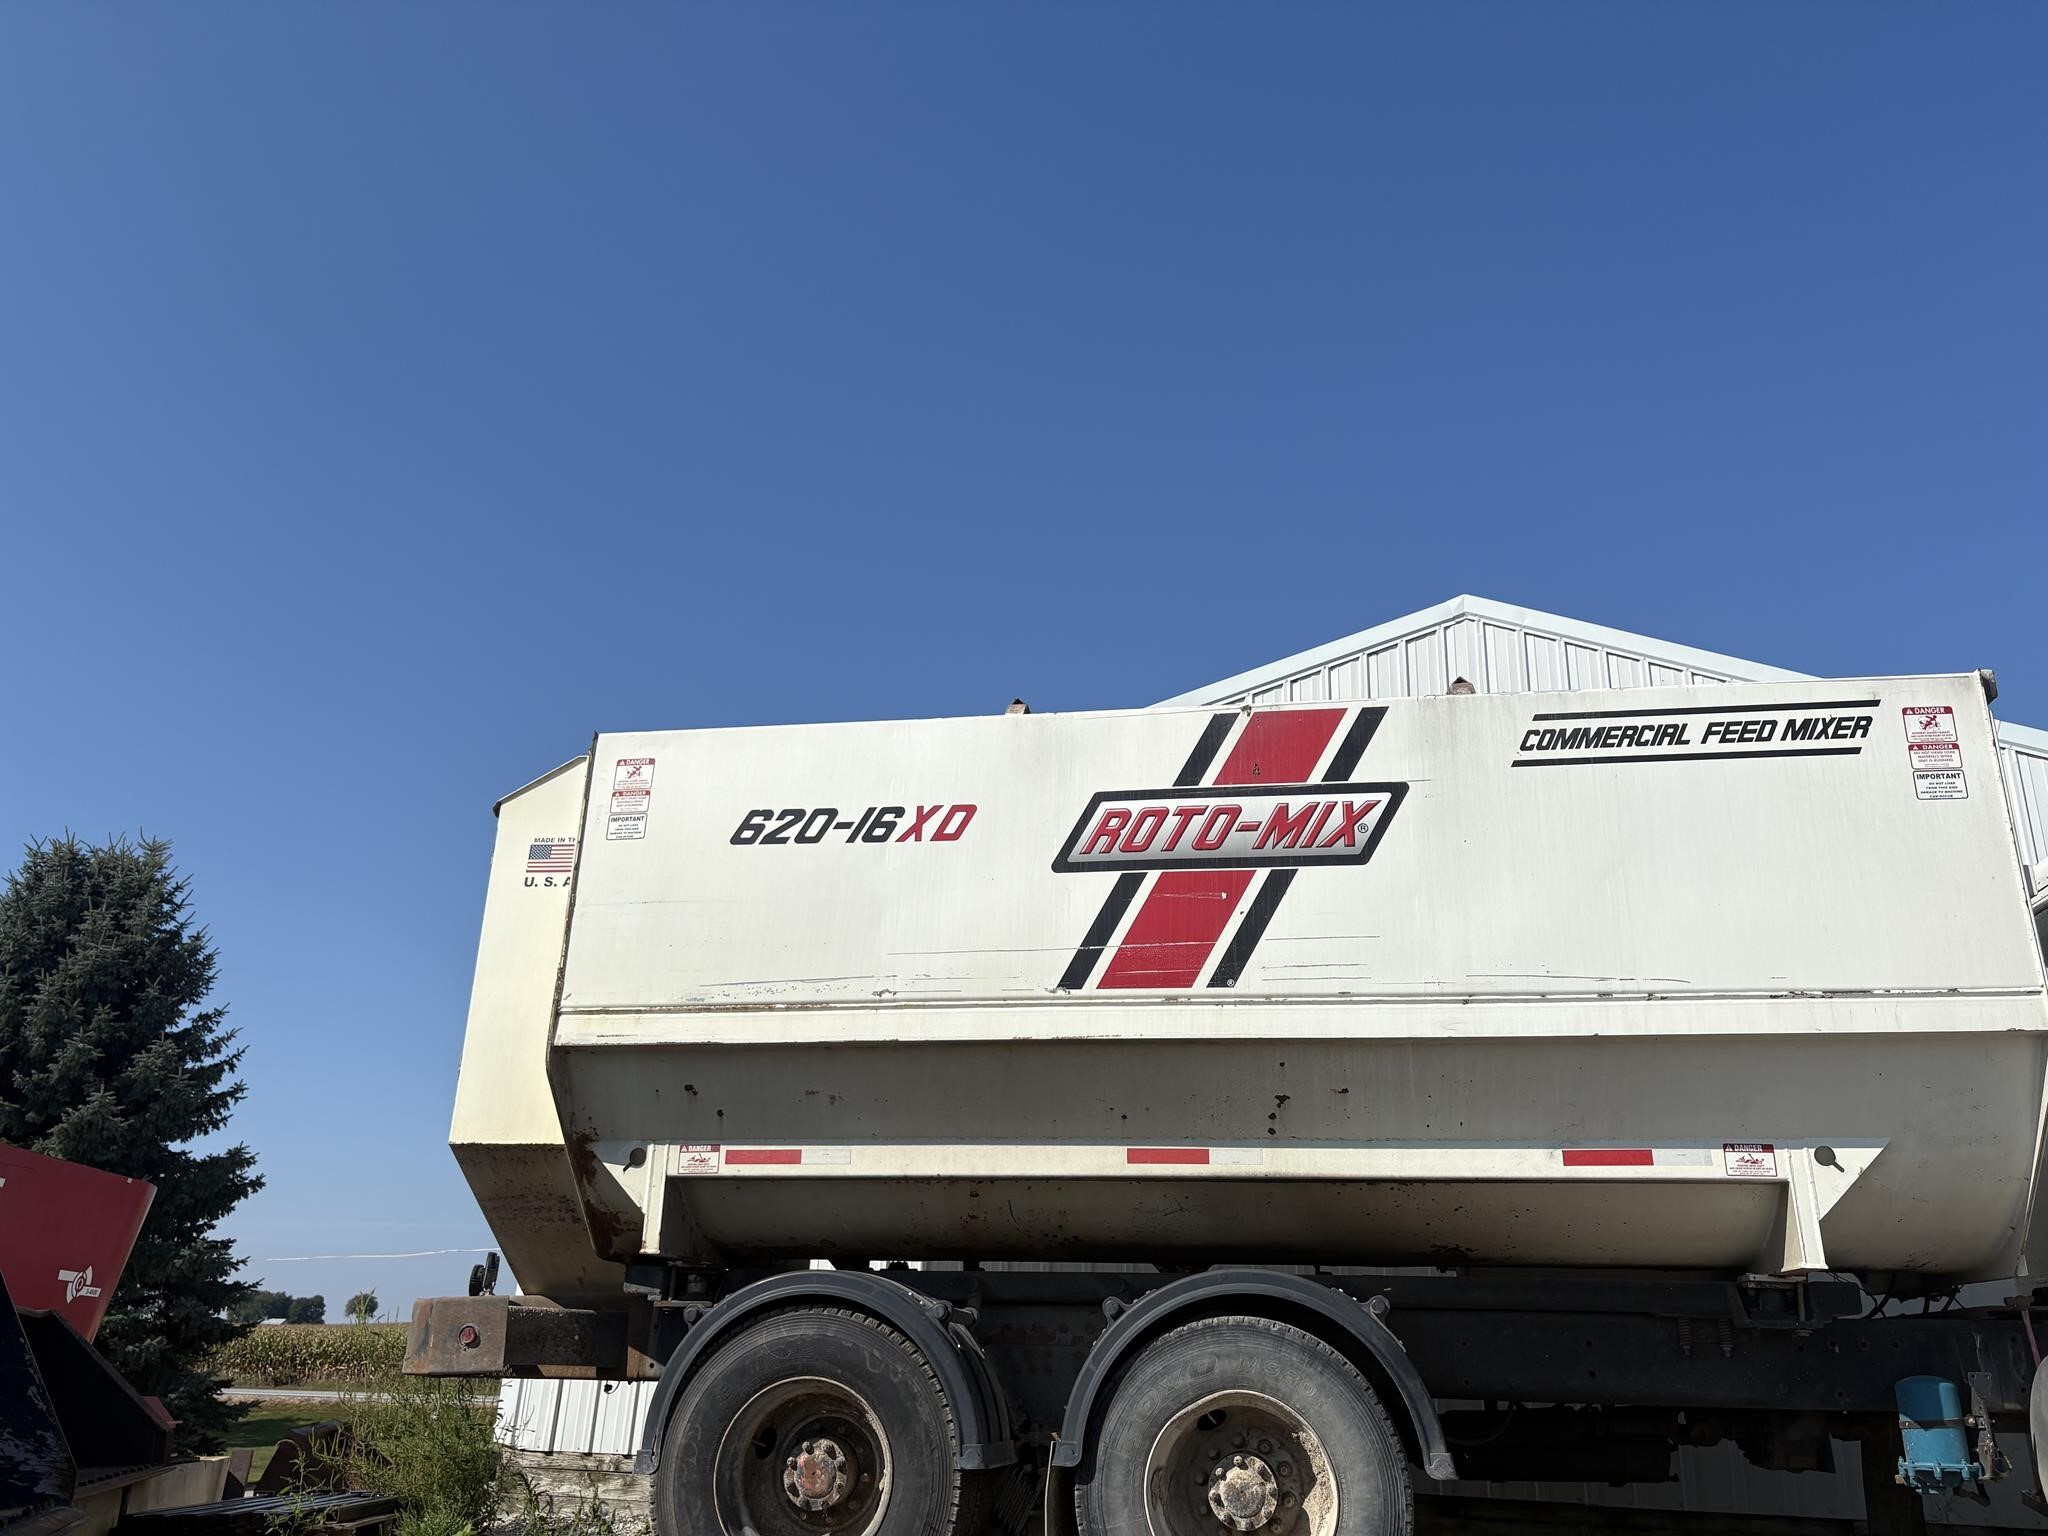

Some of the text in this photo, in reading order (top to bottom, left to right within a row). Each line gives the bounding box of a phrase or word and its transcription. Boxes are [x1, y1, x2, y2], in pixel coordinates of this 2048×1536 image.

[1914, 706, 1945, 714] DANGER
[1519, 715, 1874, 752] COMMERCIAL FEED MIXER
[626, 758, 650, 766] DANGER
[1916, 772, 1961, 780] IMPORTANT
[610, 815, 645, 823] IMPORTANT
[729, 804, 978, 846] 620-16XD
[1734, 1144, 1763, 1152] DANGER
